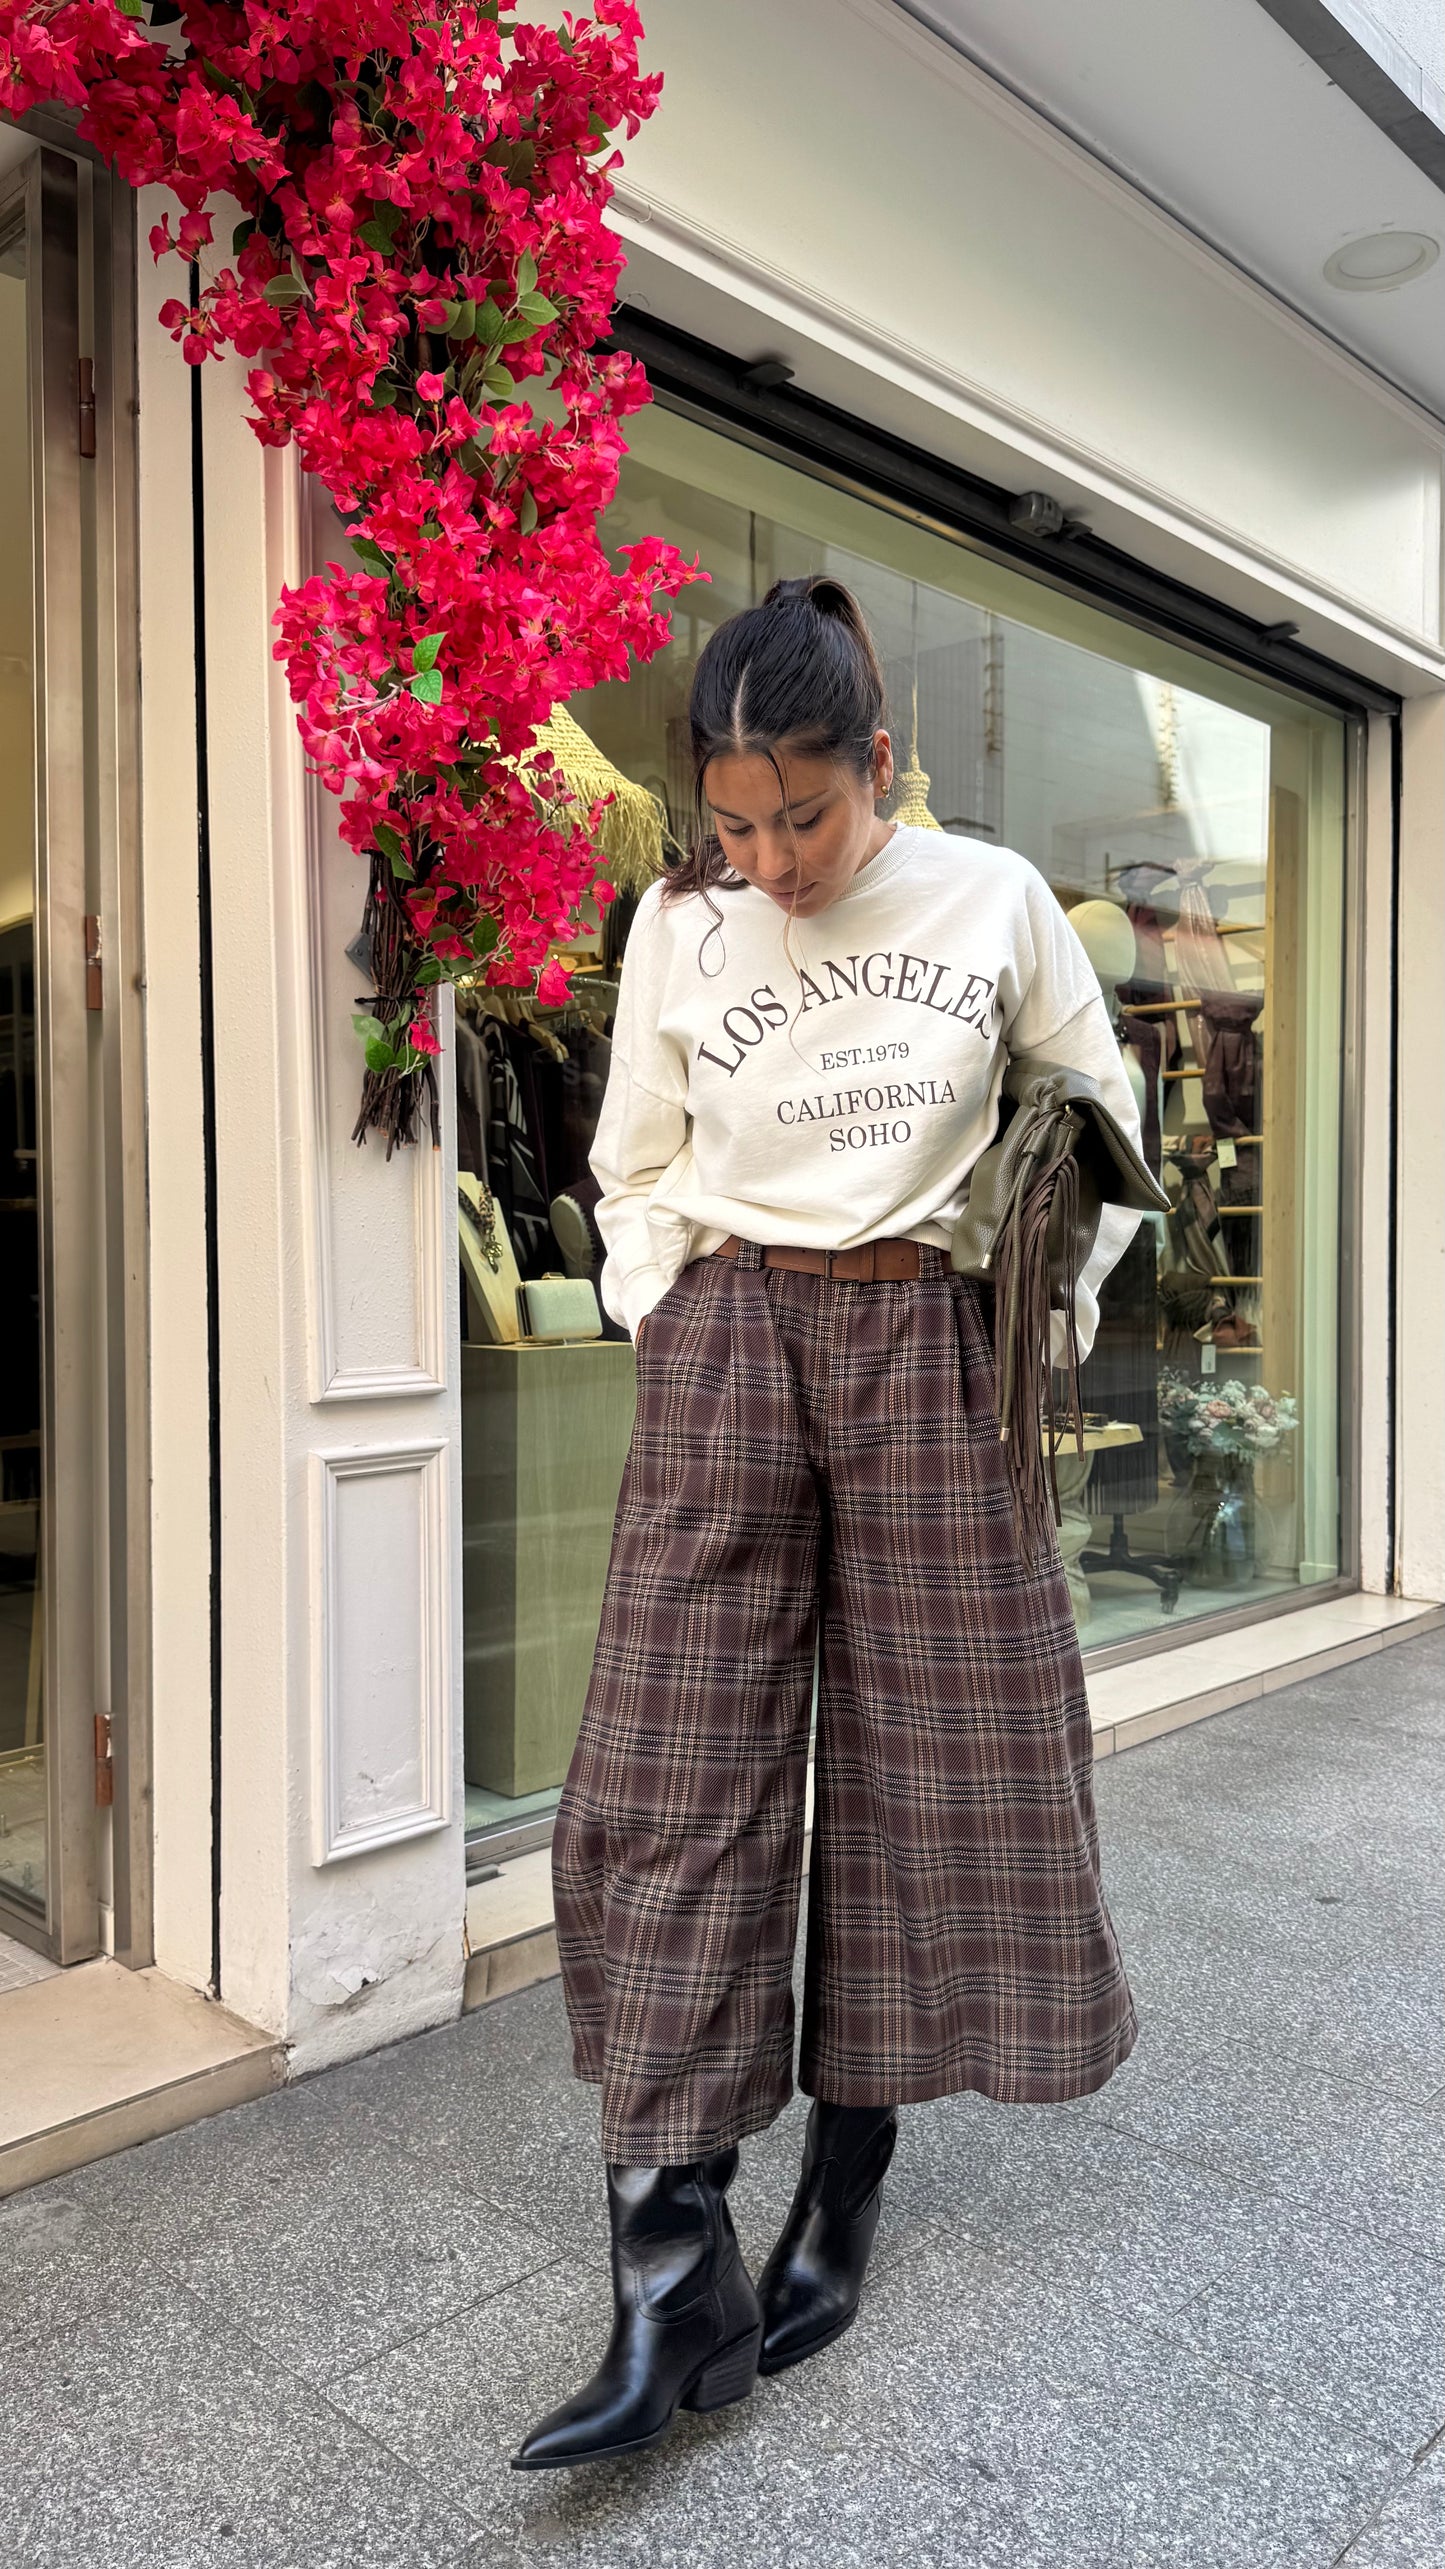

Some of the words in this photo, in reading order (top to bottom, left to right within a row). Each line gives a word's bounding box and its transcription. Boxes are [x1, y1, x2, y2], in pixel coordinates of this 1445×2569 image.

[697, 984, 788, 1078] LOS
[820, 1042, 910, 1071] EST.1979
[776, 1079, 957, 1125] CALIFORNIA
[829, 1120, 912, 1153] SOHO
